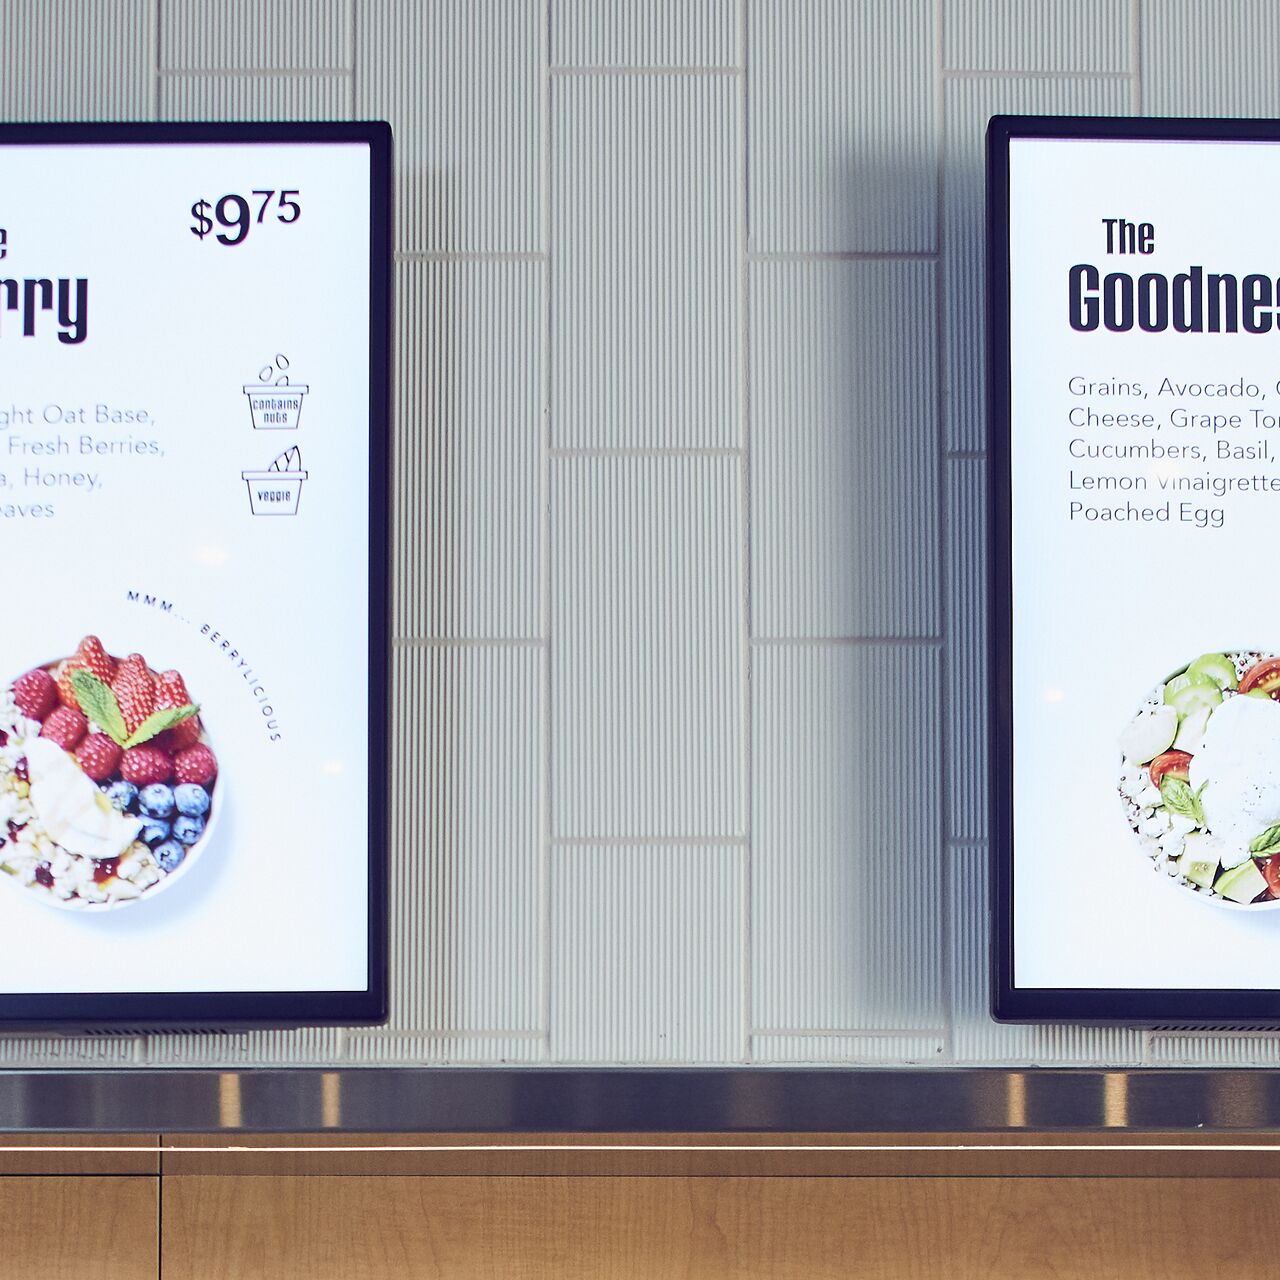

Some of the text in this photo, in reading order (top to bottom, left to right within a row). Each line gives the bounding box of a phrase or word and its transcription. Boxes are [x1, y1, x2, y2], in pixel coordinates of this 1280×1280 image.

[1102, 219, 1154, 255] The
[1068, 376, 1148, 399] Grains,
[1158, 377, 1266, 400] Avocado,
[43, 405, 85, 424] Oat
[95, 404, 154, 425] Base,
[1069, 407, 1161, 430] Cheese,
[1170, 408, 1241, 433] Grape
[9, 435, 69, 455] Fresh
[79, 435, 164, 456] Berries,
[1069, 438, 1206, 462] Cucumbers,
[1217, 440, 1275, 463] Basil,
[24, 468, 102, 491] Honey,
[1070, 470, 1146, 490] Lemon
[1070, 501, 1224, 528] Poached Egg
[200, 623, 282, 742] BERRYLICIOUS
